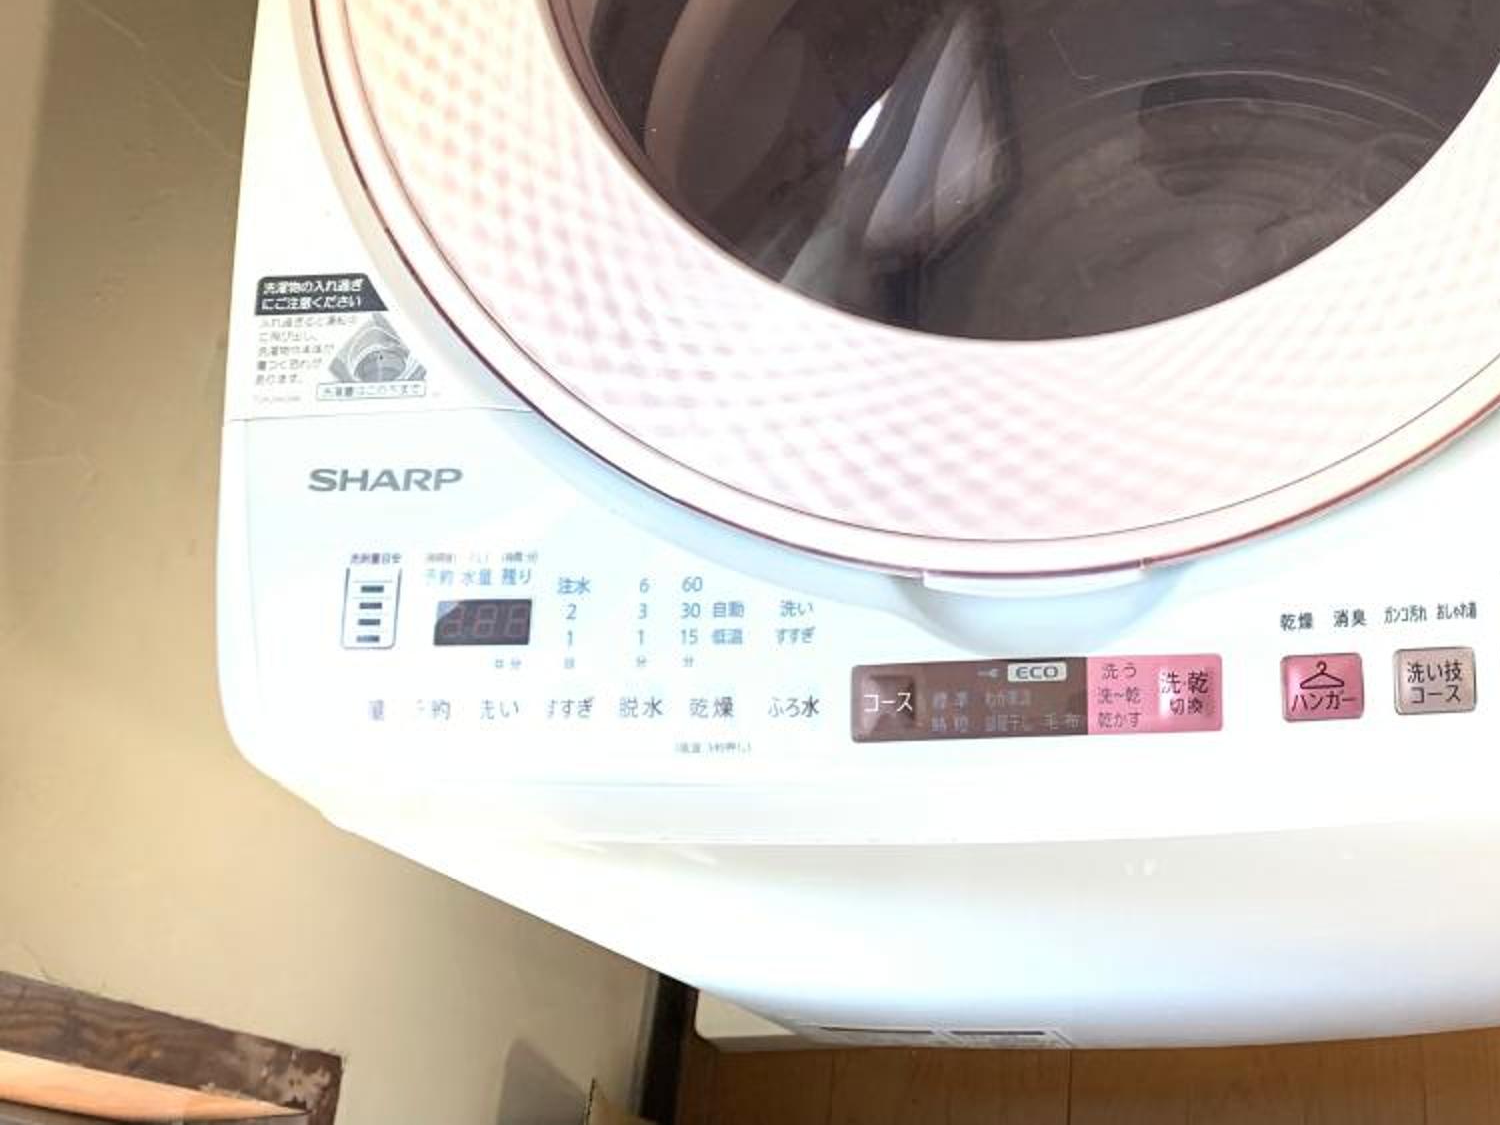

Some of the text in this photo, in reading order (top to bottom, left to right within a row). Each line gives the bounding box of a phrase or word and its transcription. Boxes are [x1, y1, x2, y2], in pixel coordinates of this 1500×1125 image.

[263, 278, 364, 295] 洗濯物の入れ過ぎ
[261, 295, 362, 311] にご注意ください
[308, 468, 464, 492] SHARP
[556, 577, 592, 595] 注水
[639, 577, 650, 593] 6
[682, 576, 703, 593] 60
[565, 603, 577, 620] 2
[638, 603, 649, 619] 3
[681, 603, 702, 619] 30
[712, 601, 745, 618] 自動
[780, 600, 814, 618] 洗い
[1280, 613, 1314, 631] 乾燥
[1333, 610, 1367, 627] 消臭
[681, 628, 698, 644] 15
[711, 628, 744, 645] 低温
[1016, 665, 1060, 680] ECO
[1102, 663, 1138, 680] 洗う
[1407, 660, 1465, 684] 洗い技
[864, 691, 914, 713] コース
[1291, 690, 1358, 712] ハンガー
[1411, 685, 1463, 705] コース
[619, 696, 664, 718] 脱水
[689, 695, 735, 718] 乾燥
[767, 695, 820, 718] ふろ水
[1168, 698, 1205, 715] 切換
[1098, 711, 1142, 729] 乾かす
